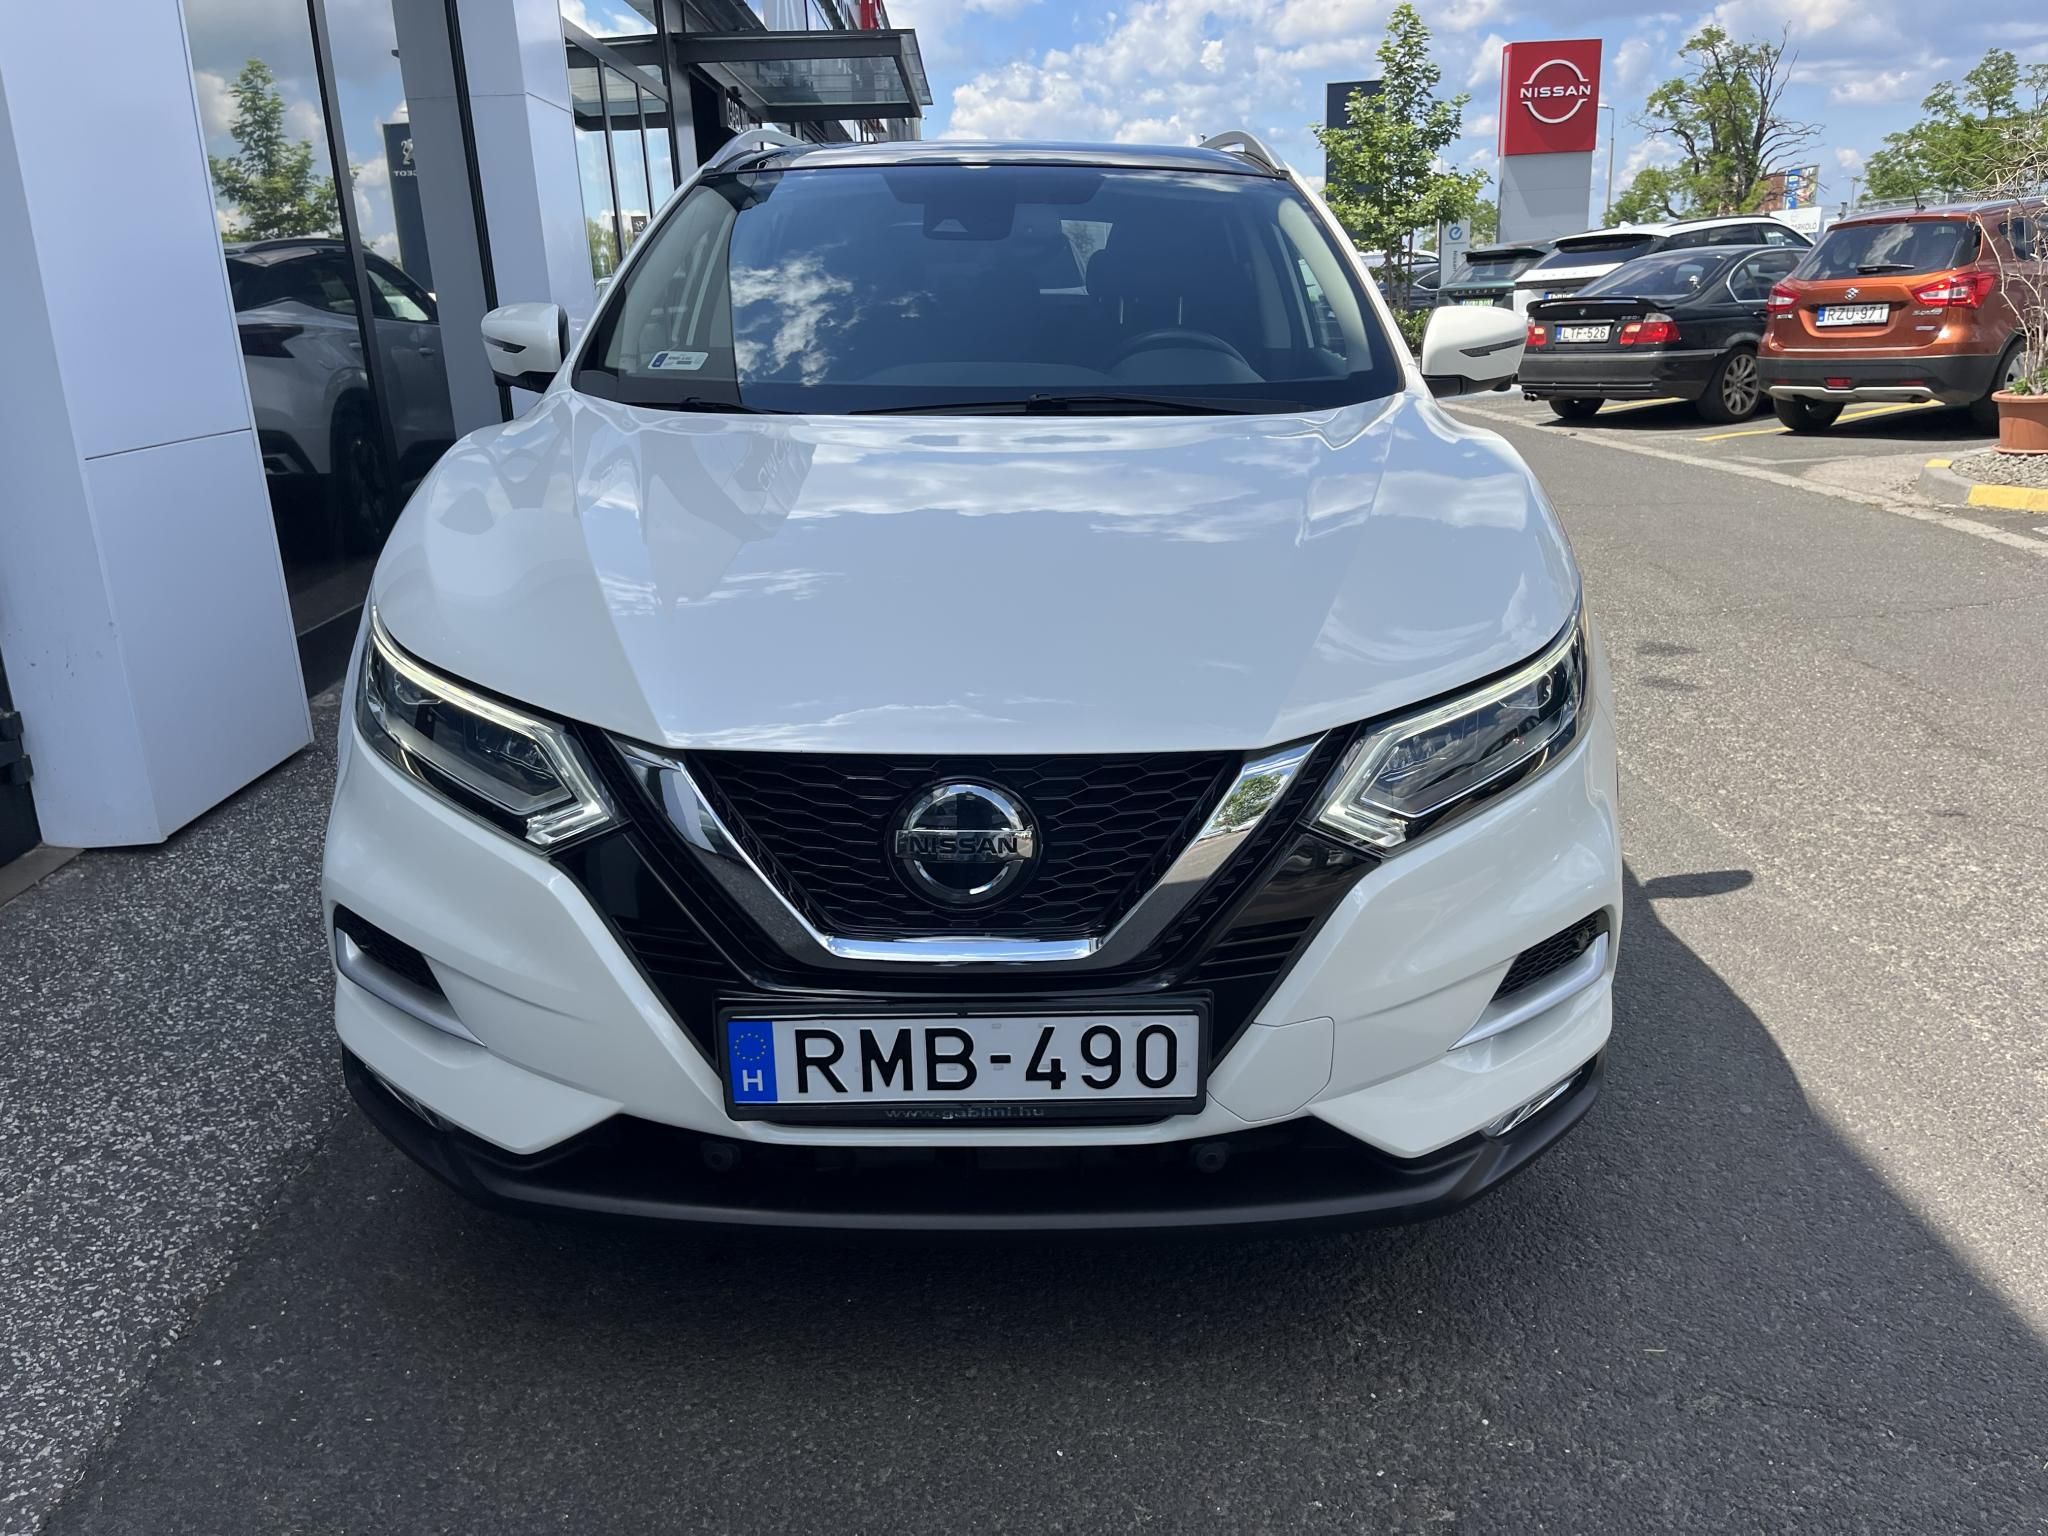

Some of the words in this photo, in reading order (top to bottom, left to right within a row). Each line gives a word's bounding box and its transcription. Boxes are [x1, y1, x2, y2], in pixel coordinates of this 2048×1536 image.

[1520, 85, 1591, 98] NISSAN
[1826, 305, 1885, 321] RZU-971
[1562, 327, 1606, 339] LTF-526
[909, 836, 1018, 855] NISSAN
[796, 1023, 1178, 1093] RMB-490
[742, 1069, 763, 1091] H
[885, 1106, 1045, 1120] www.gablini.hu
